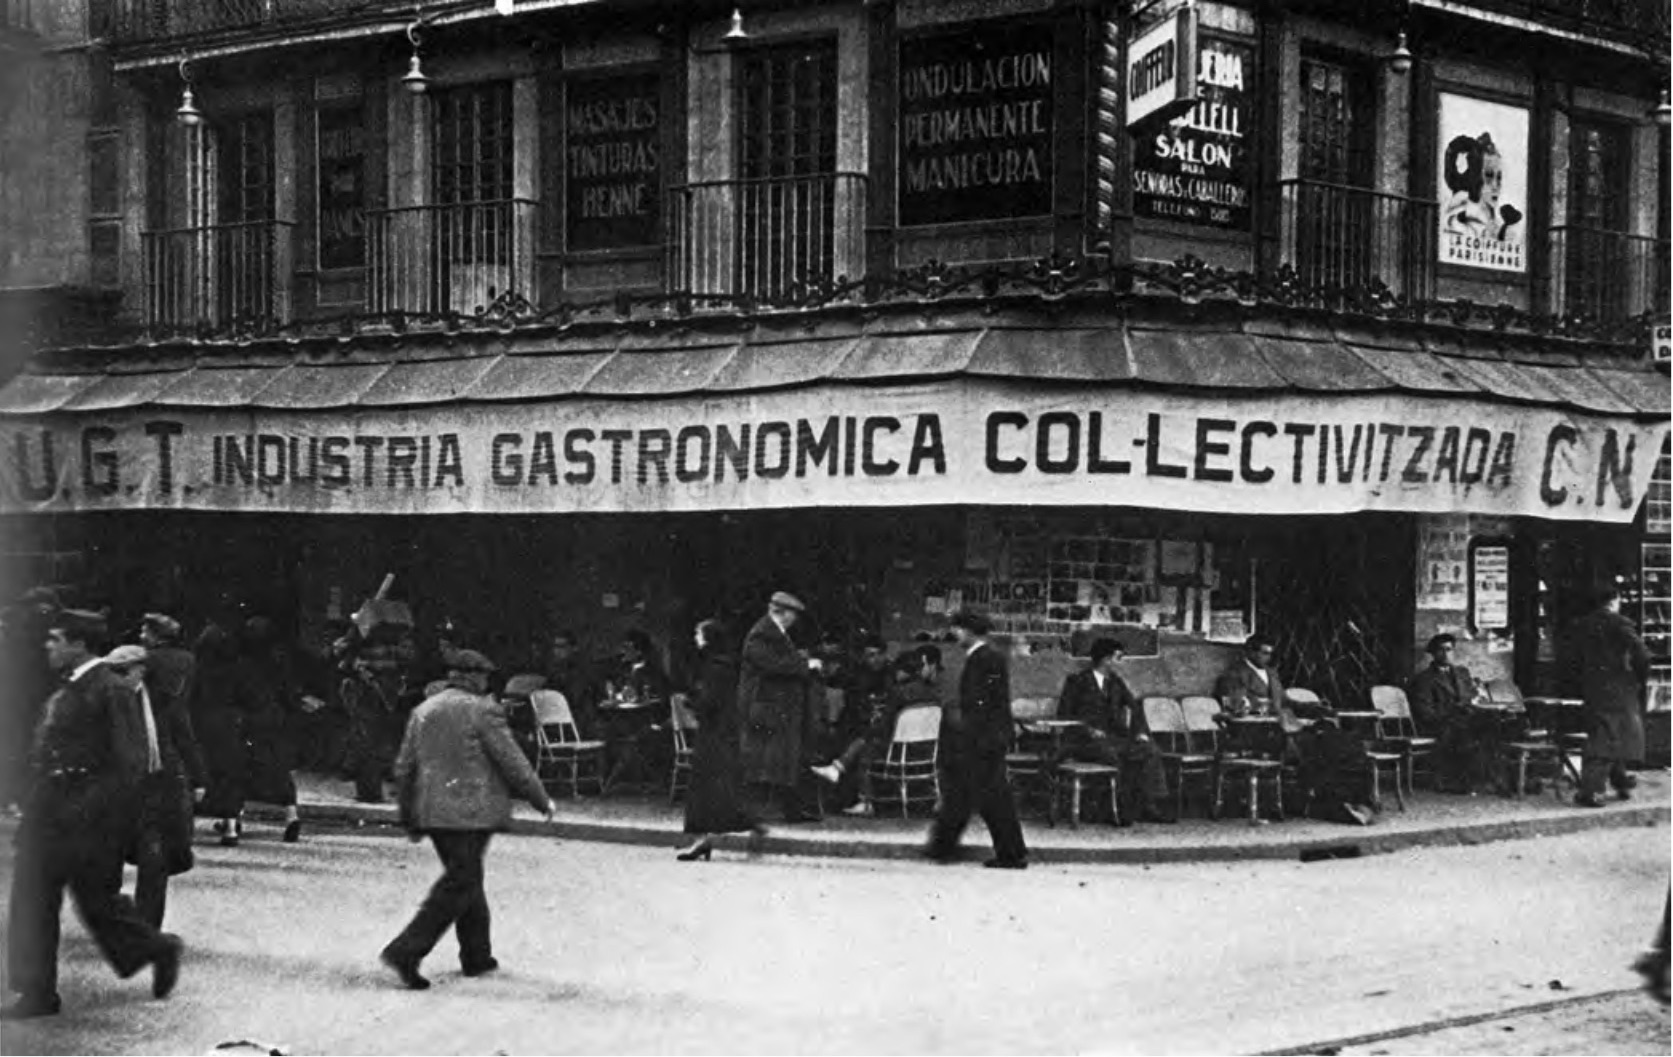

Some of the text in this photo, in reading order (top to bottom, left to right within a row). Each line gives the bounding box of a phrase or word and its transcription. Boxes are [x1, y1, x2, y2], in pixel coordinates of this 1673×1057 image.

[903, 51, 1051, 101] ONDULACION
[568, 97, 657, 135] MASAJES
[903, 99, 1047, 150] PERMANENTE
[568, 140, 659, 178] TINTURAS
[905, 146, 1042, 193] MANICURA
[1154, 134, 1233, 169] SALON
[581, 182, 649, 218] HENNE
[1449, 247, 1521, 268] PARISIENNE
[212, 433, 465, 489] INDUSTRIA
[490, 412, 947, 487] GASTRONOMICA
[985, 410, 1516, 486] COL-LECTIVITZADA
